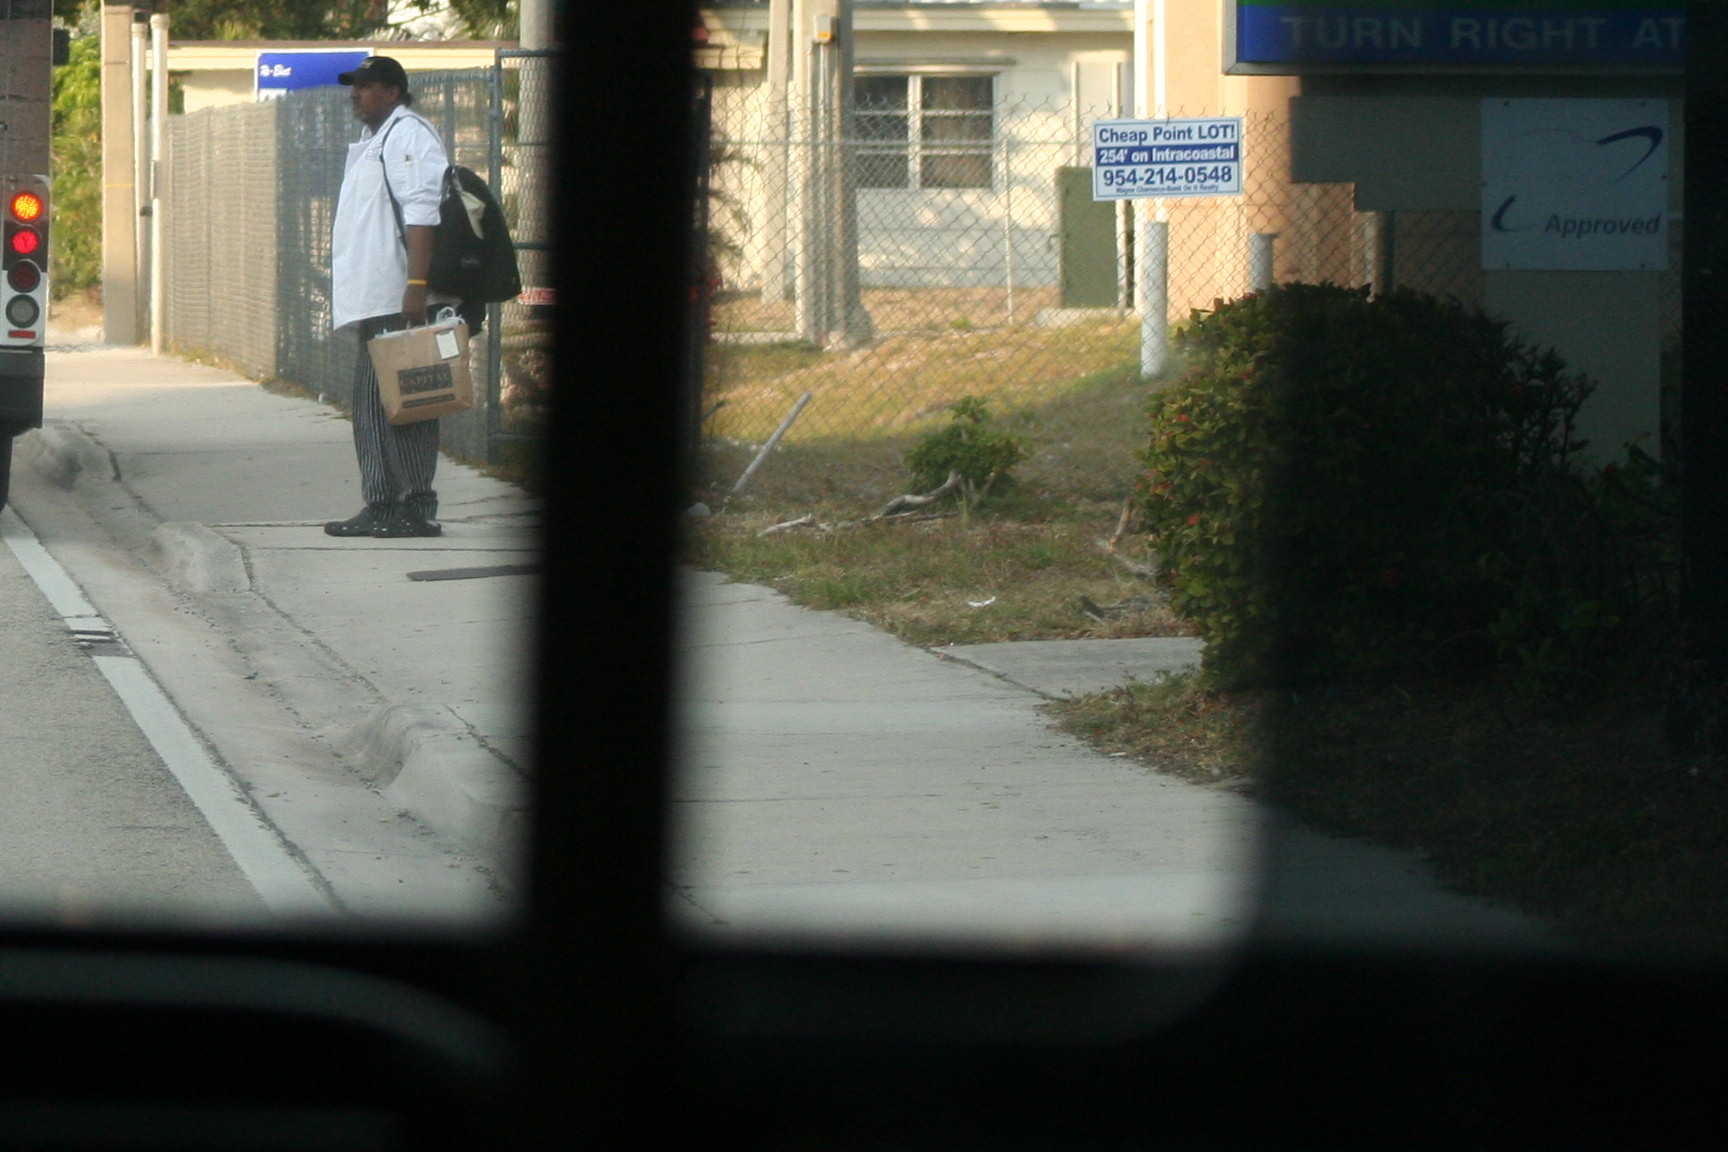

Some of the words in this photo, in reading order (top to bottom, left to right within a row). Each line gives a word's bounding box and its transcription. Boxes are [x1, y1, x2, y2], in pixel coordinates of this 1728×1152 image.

[1281, 16, 1422, 51] TURN
[1450, 16, 1606, 51] RIGHT
[1631, 16, 1687, 51] AT
[1099, 128, 1148, 145] Cheap
[1153, 125, 1193, 141] Point
[1198, 124, 1235, 140] LOT!
[1099, 149, 1128, 164] 254'
[1131, 153, 1149, 163] on
[1152, 146, 1234, 162] Intracoastal
[1103, 165, 1232, 187] 954-214-0548
[1544, 213, 1662, 239] Approved
